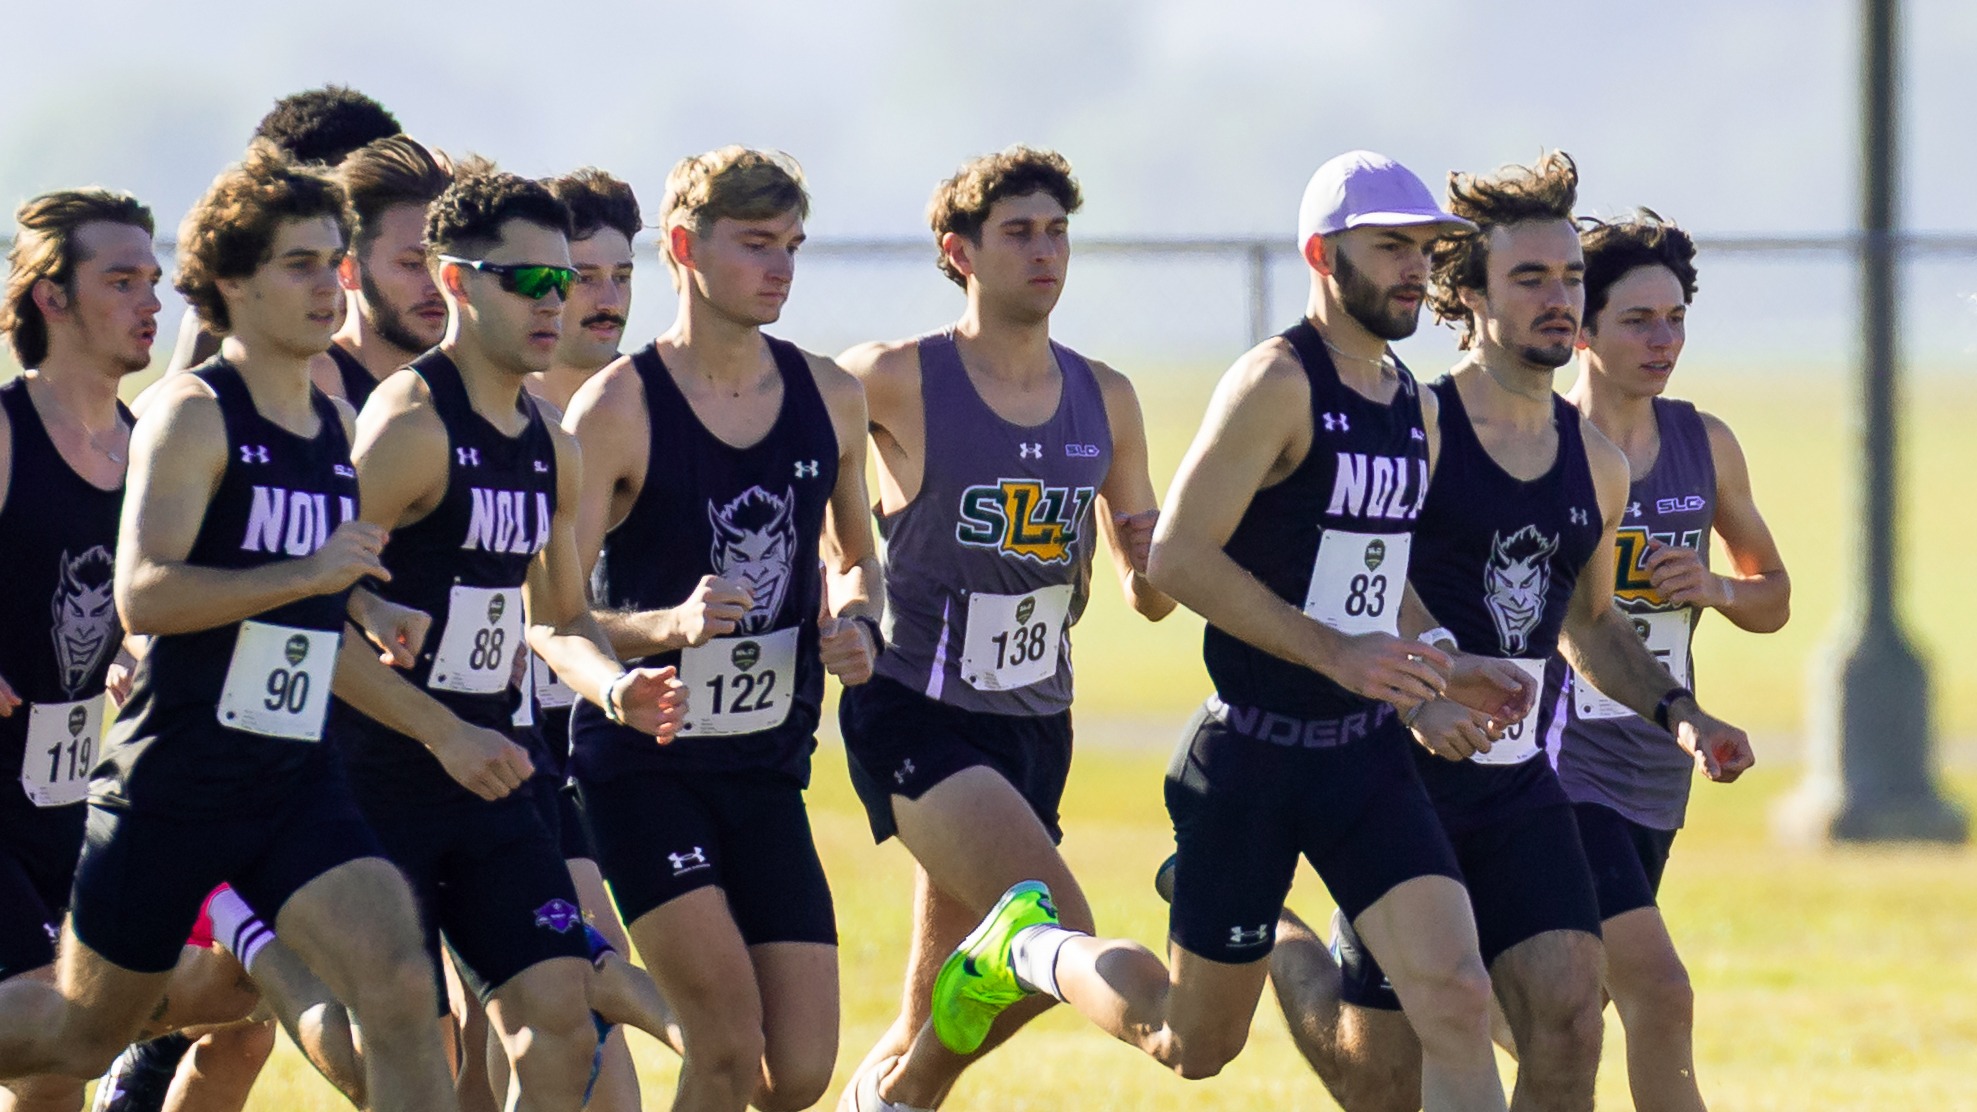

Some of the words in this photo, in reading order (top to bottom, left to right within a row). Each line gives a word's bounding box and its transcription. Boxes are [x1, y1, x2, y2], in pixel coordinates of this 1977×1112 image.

[956, 478, 1095, 565] SLU
[1656, 496, 1706, 514] SLC
[1345, 573, 1387, 618] 83
[469, 627, 505, 671] 88
[991, 621, 1047, 670] 138
[263, 668, 310, 715] 90
[706, 669, 776, 715] 122
[47, 736, 92, 783] 119
